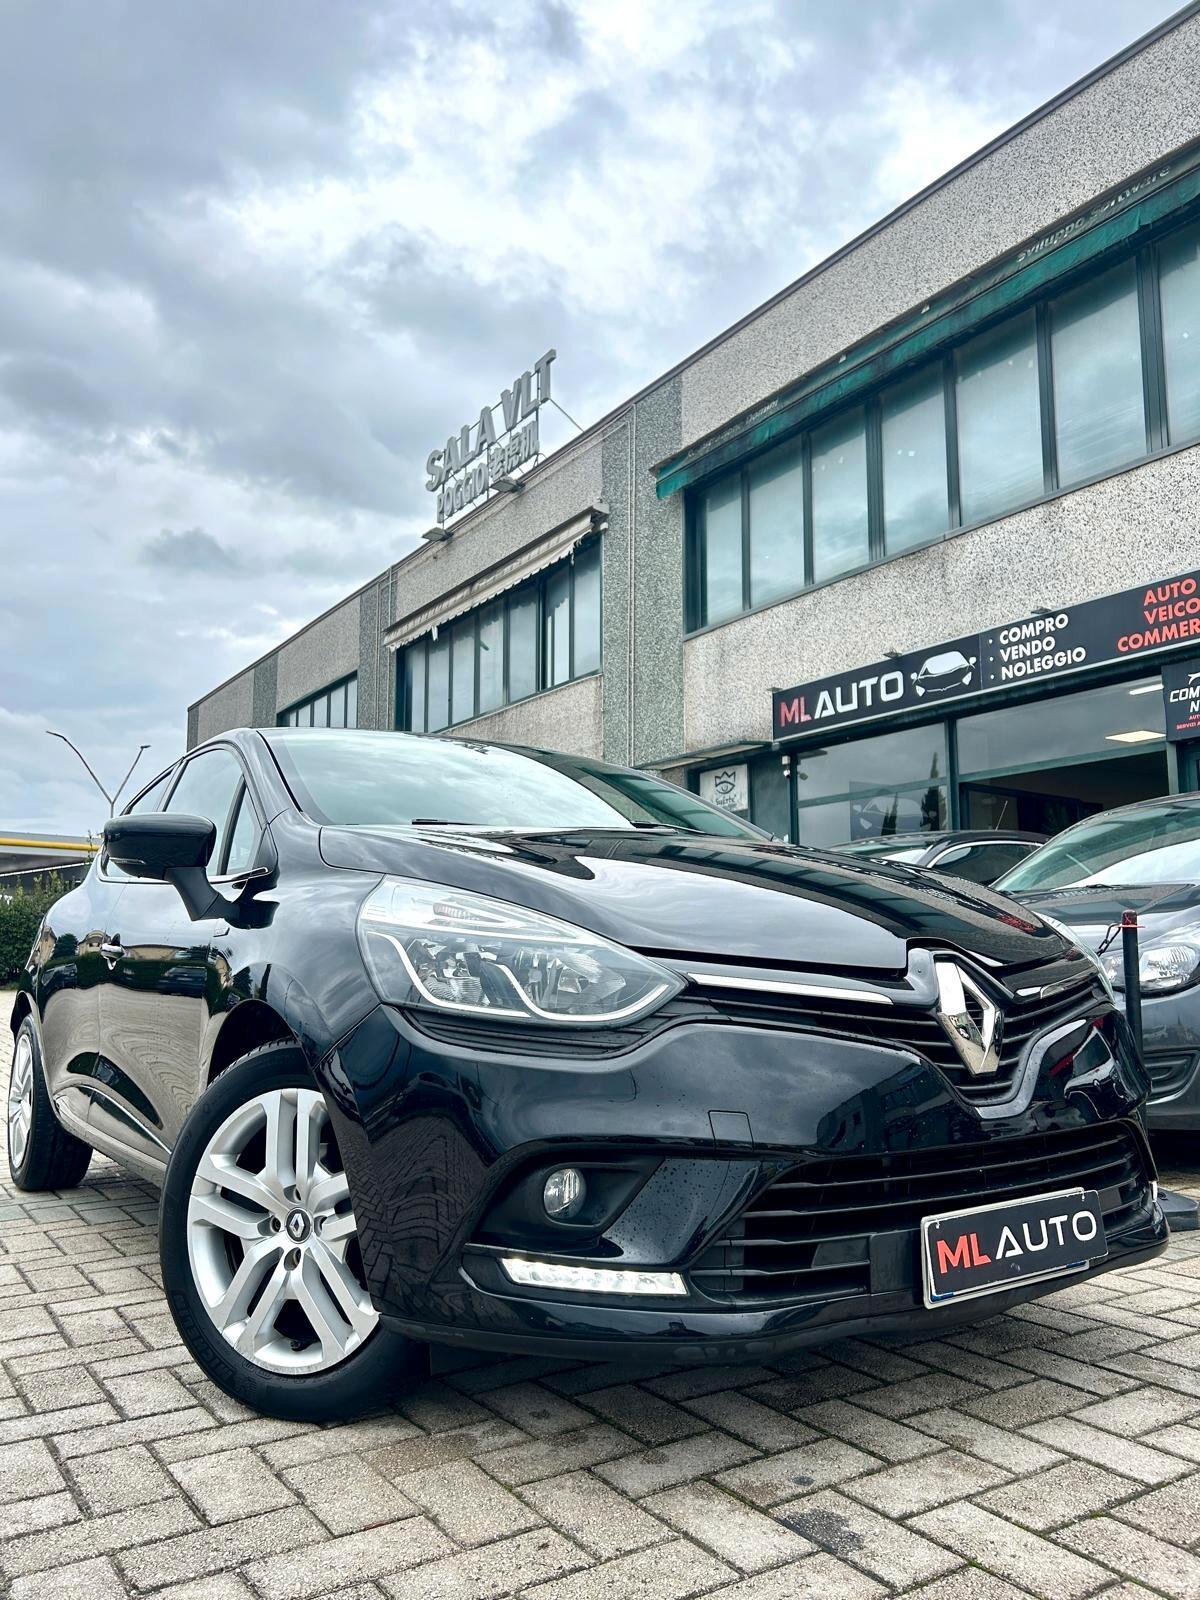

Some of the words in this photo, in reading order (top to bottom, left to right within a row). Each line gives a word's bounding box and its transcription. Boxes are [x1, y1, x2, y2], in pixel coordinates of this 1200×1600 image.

[425, 406, 496, 492] SALA
[500, 348, 556, 432] VLT
[437, 462, 489, 523] POGGIO
[1143, 578, 1197, 606] AUTO
[1000, 613, 1069, 645] COMPRO
[1000, 636, 1056, 662] VENDO
[1001, 647, 1086, 680] NOLEGGIO
[996, 1210, 1097, 1260] AUTO
